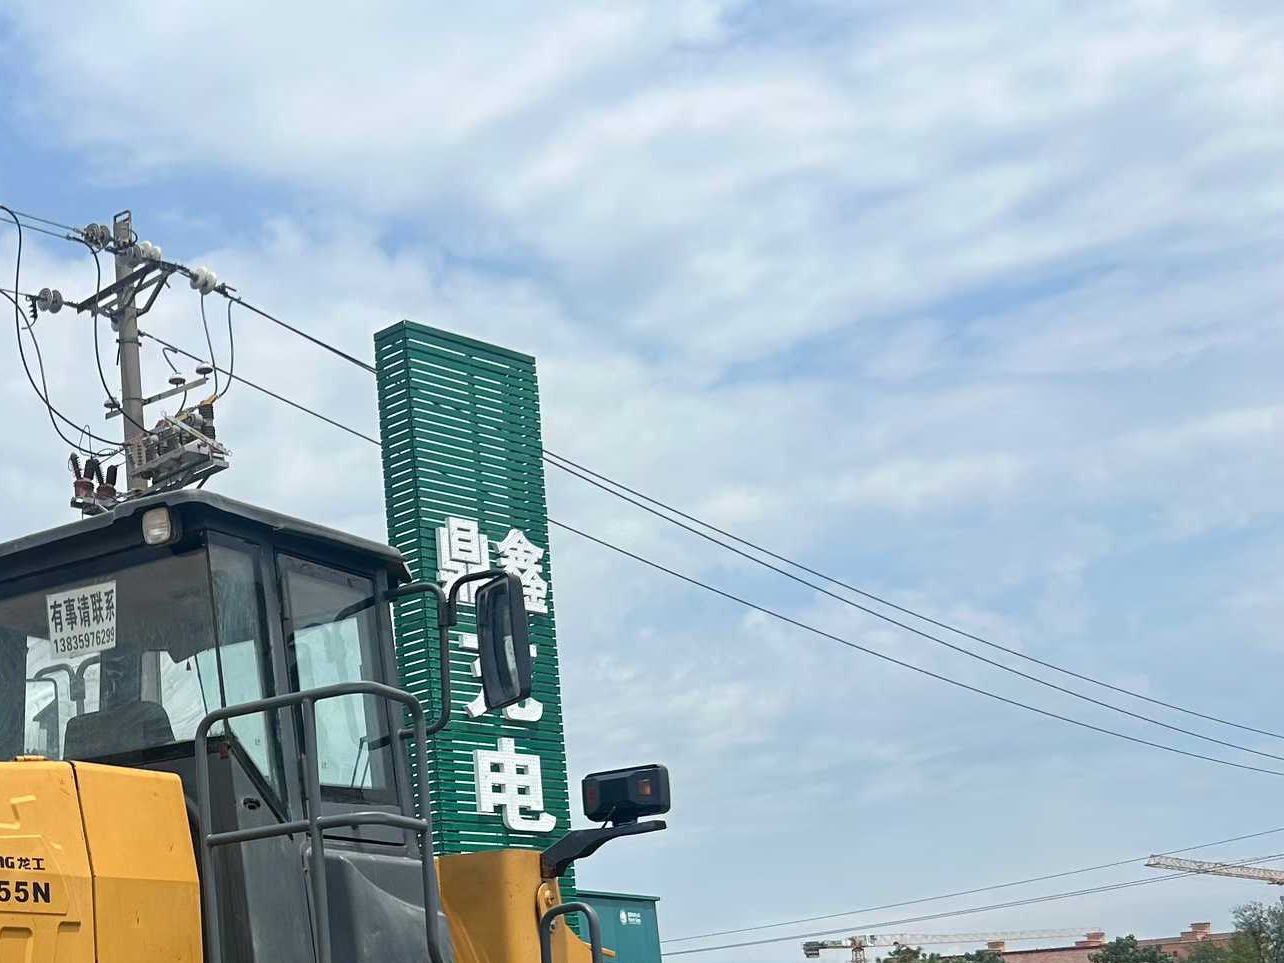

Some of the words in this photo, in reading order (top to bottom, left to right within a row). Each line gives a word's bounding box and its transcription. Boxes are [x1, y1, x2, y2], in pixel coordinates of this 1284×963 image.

[50, 589, 115, 633] 有事请联系
[53, 626, 115, 653] 13835976299
[17, 857, 46, 870] 龙工
